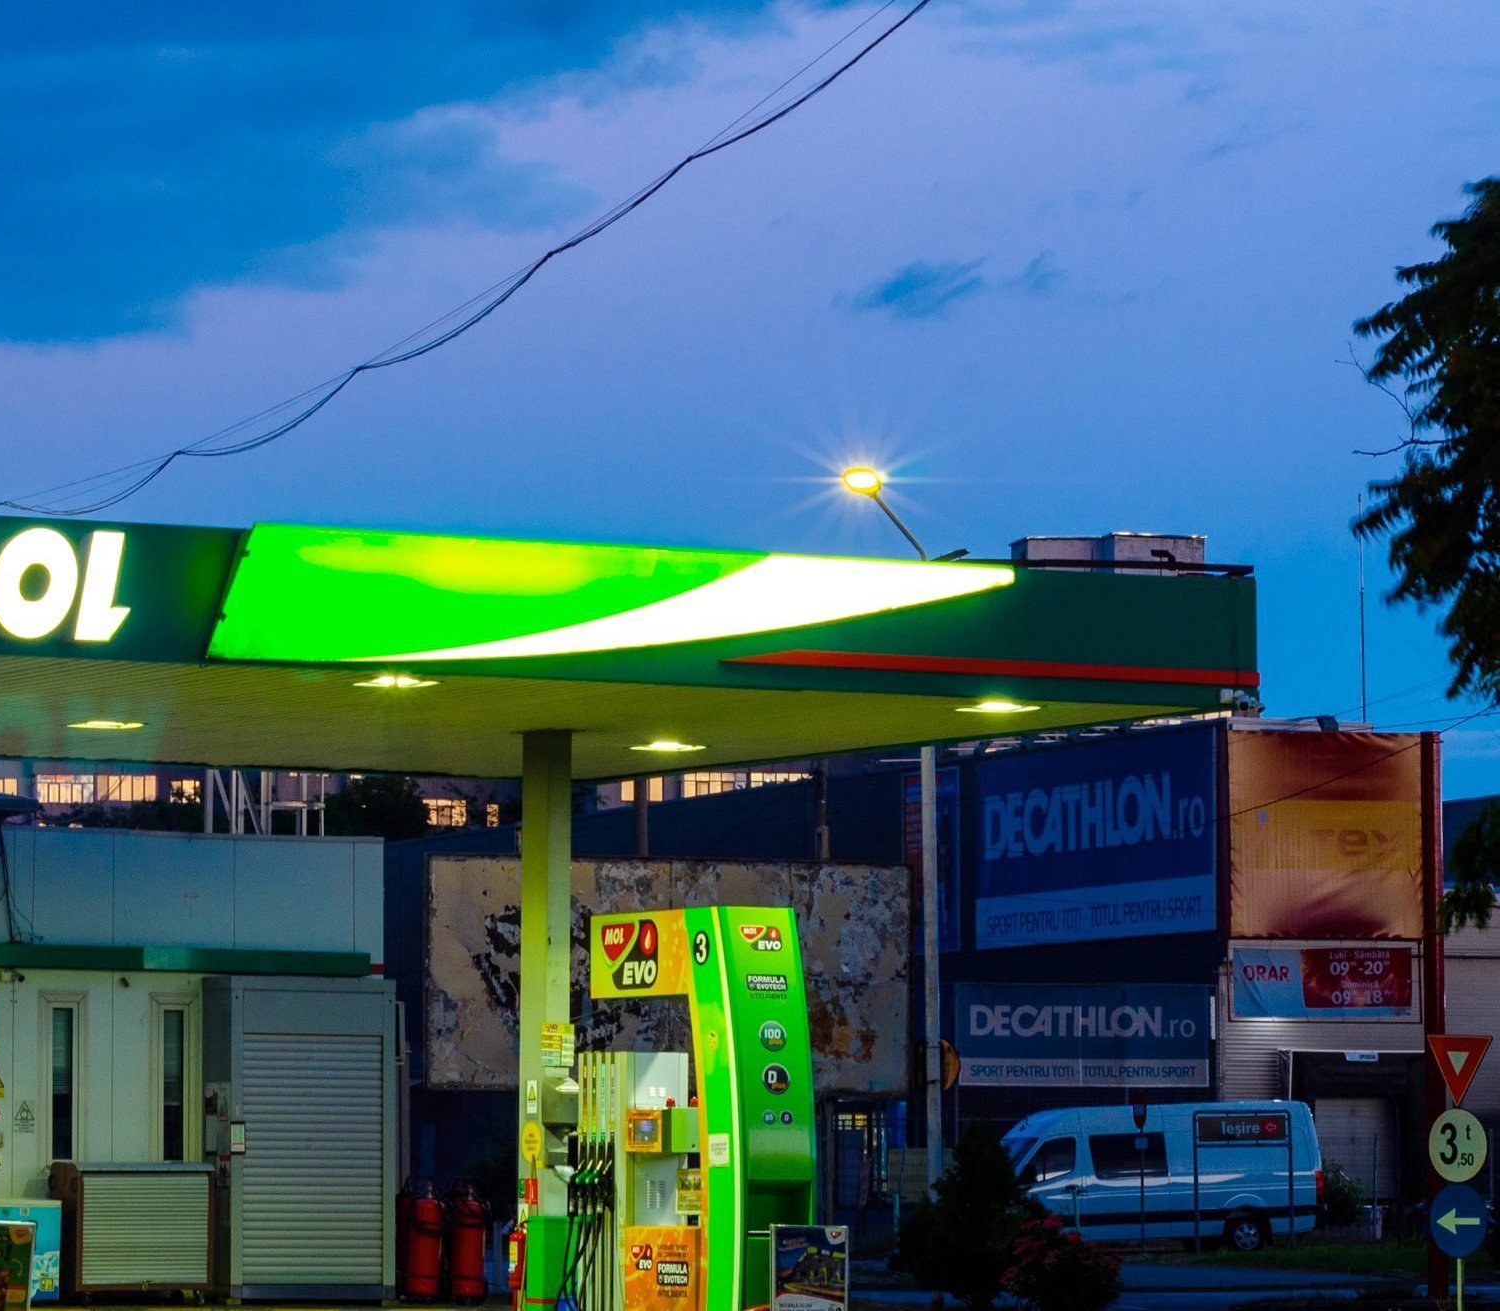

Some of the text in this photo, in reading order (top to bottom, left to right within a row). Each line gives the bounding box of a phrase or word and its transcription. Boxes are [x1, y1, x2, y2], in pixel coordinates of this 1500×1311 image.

[985, 771, 1206, 862] DECATHLON.ro
[987, 913, 1017, 936] SPORT
[1020, 907, 1060, 934] PENTRU
[1090, 901, 1122, 928] TOTUL
[1124, 898, 1165, 925] PENTRU
[1166, 894, 1204, 920] SPORT
[604, 927, 625, 946] MOL
[695, 933, 708, 964] 3
[757, 940, 782, 950] EVO
[1329, 951, 1348, 959] Luni
[622, 959, 657, 986] EVO
[747, 975, 786, 984] FORMULA
[1243, 965, 1290, 981] ORAR
[969, 1004, 1196, 1038] DECATHLON.ro
[764, 1028, 781, 1039] 100
[768, 1070, 777, 1084] D
[970, 1065, 1003, 1078] SPORT
[1006, 1065, 1050, 1078] PENTRU
[1084, 1065, 1117, 1078] TOTUL
[1119, 1065, 1161, 1078] PENTRU
[1162, 1065, 1196, 1079] SPORT
[638, 1259, 653, 1270] EVO
[657, 1263, 688, 1275] FORMULA
[664, 1275, 688, 1284] EVOTECH
